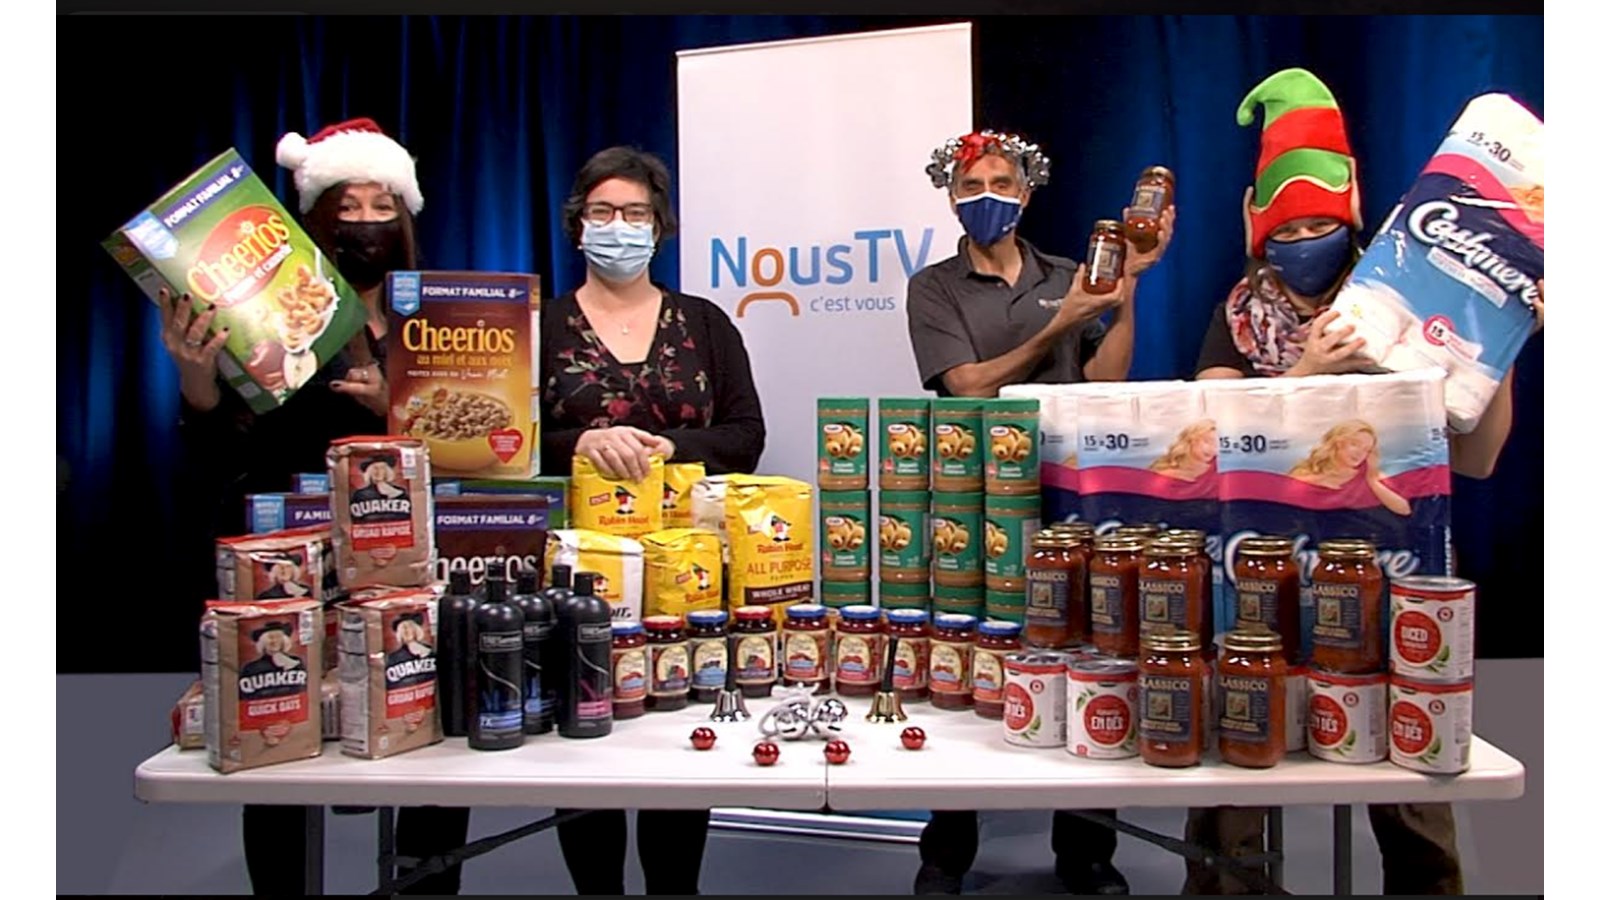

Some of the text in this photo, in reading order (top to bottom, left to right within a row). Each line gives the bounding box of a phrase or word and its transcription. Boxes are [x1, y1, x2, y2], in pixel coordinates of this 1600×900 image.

[1488, 141, 1512, 163] 30
[163, 174, 235, 229] FORMAT FAMILIAL
[187, 213, 291, 301] Cheerios
[710, 228, 934, 289] NousTV
[422, 286, 462, 297] FORMAT
[462, 287, 506, 298] FAMILIAL
[809, 297, 896, 312] c'est vous
[402, 318, 516, 354] Cheerios
[1084, 435, 1097, 446] 15
[1105, 433, 1129, 450] 30
[1240, 434, 1266, 453] 30
[295, 510, 332, 521] FAMIL
[351, 499, 411, 517] QUAKER
[437, 514, 525, 525] FORMAT FAMILIAL
[747, 557, 812, 575] ALL PURPOSE
[239, 669, 307, 693] QUAKER
[248, 699, 301, 717] QUICK OATS
